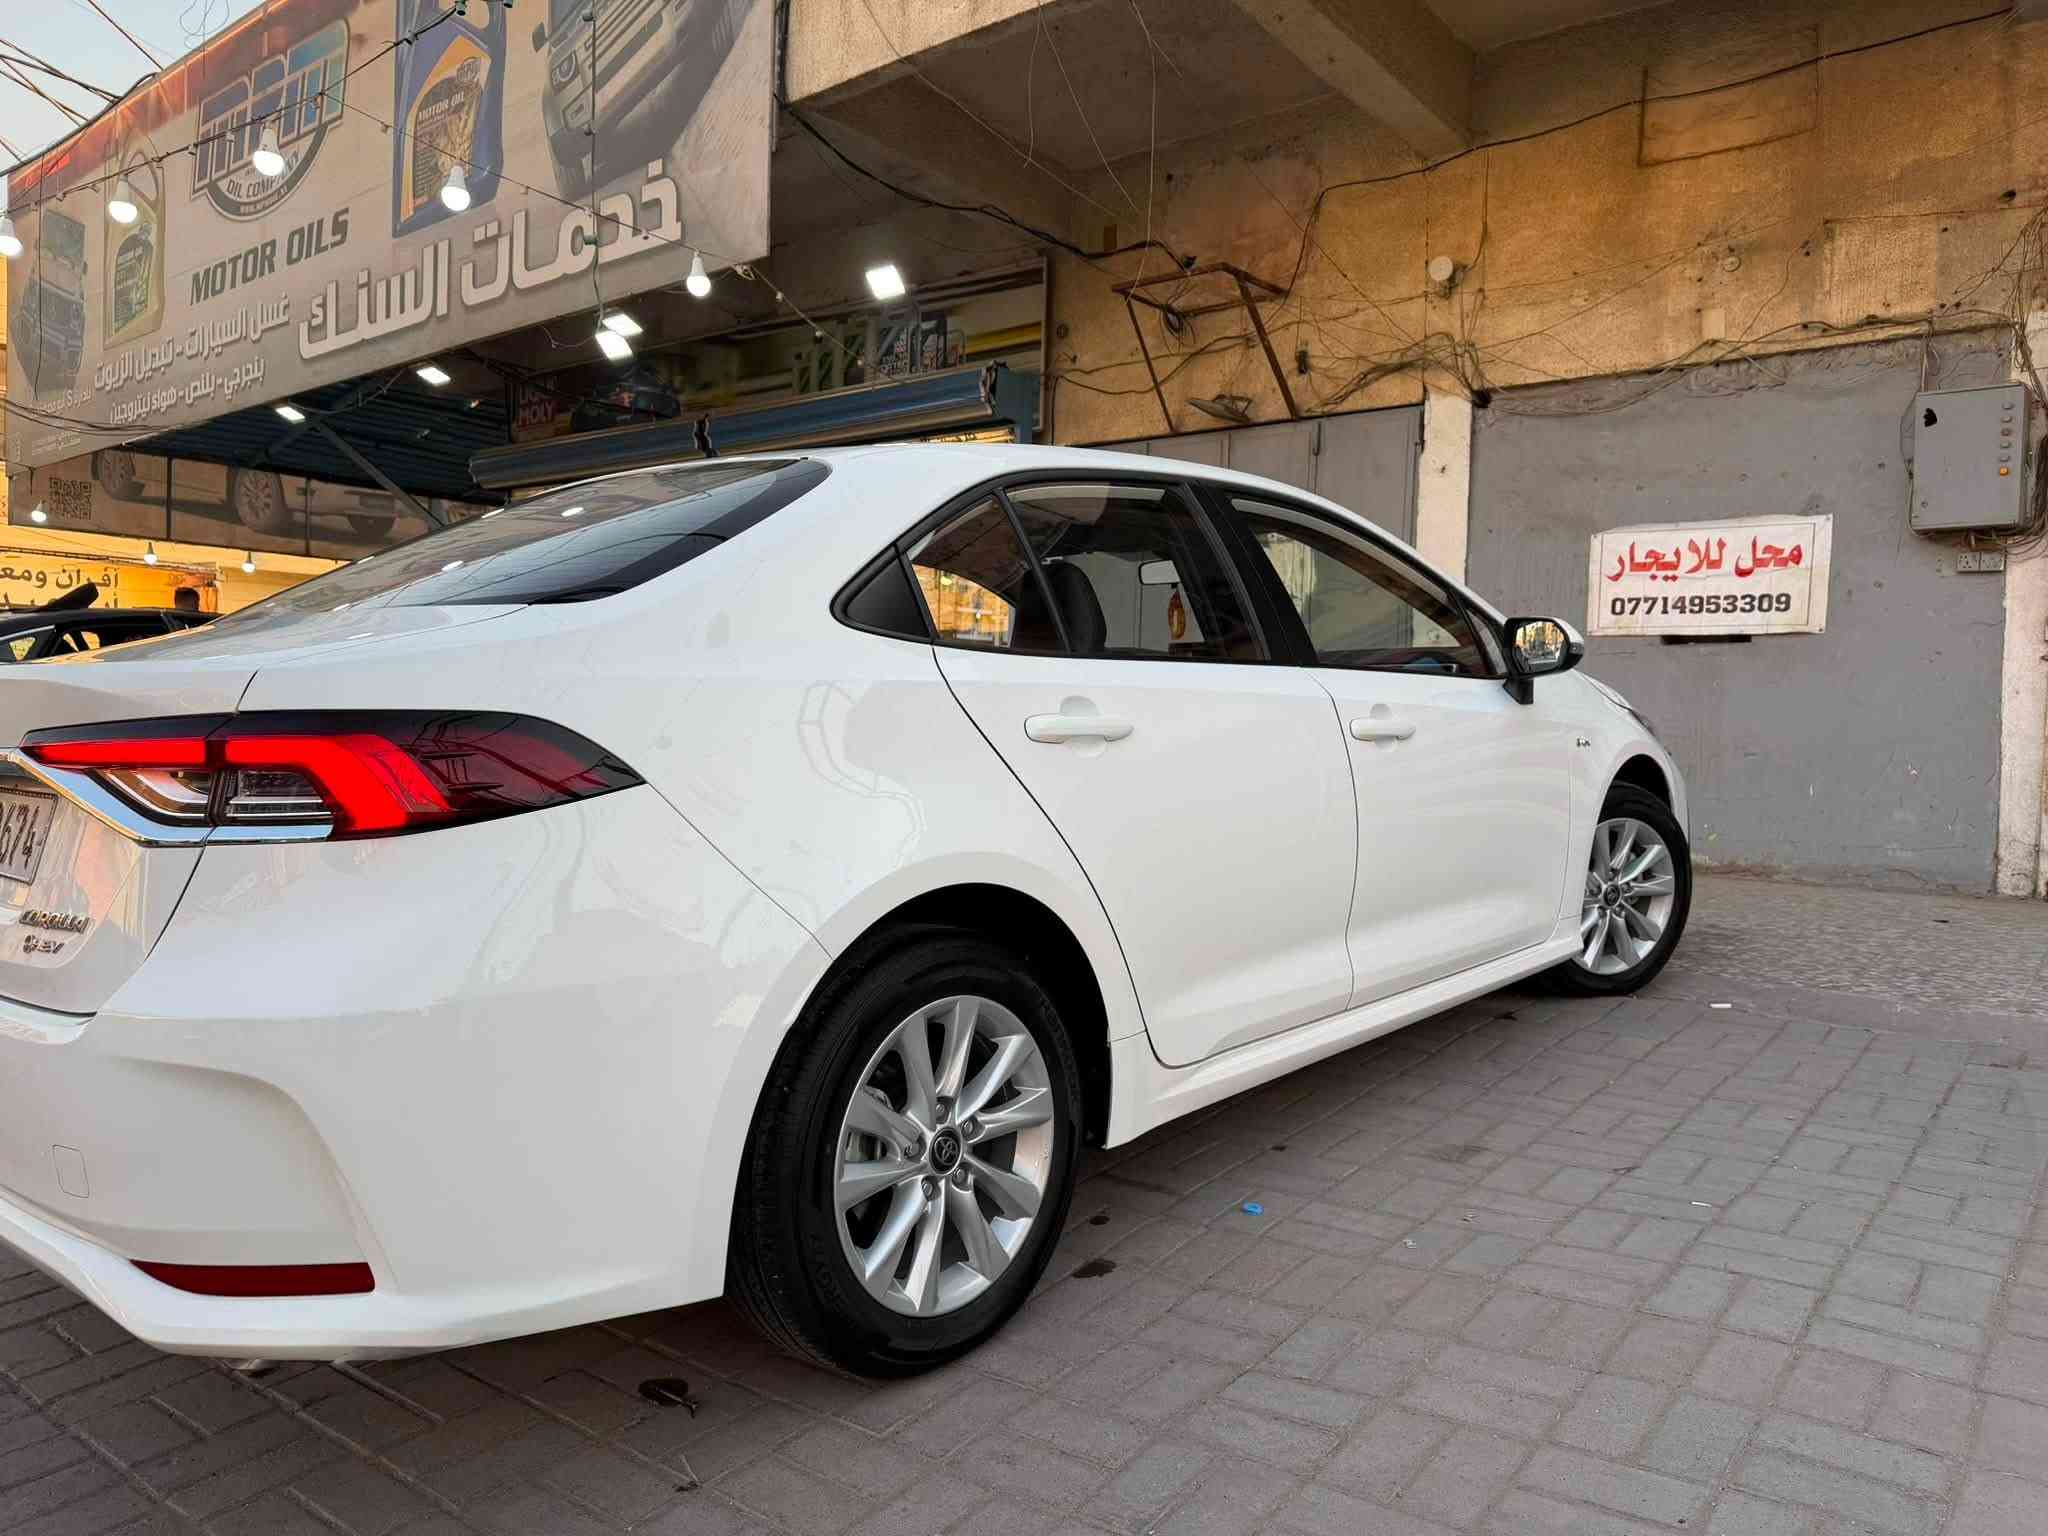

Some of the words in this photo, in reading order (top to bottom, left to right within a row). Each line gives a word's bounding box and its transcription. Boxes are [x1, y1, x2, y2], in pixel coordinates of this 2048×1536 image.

[227, 180, 241, 199] OIL
[191, 239, 277, 305] MOTOR
[286, 207, 350, 266] OILS
[460, 159, 682, 306] خدمات
[250, 292, 289, 344] غسل
[299, 239, 451, 359] السناك
[186, 307, 247, 360] السيارات
[95, 351, 133, 394] الزيوت
[135, 335, 174, 384] تبديل
[1607, 536, 1727, 583] للايجار
[1734, 535, 1803, 577] محل
[1610, 592, 1792, 616] 07714953309
[0, 802, 40, 870] 674
